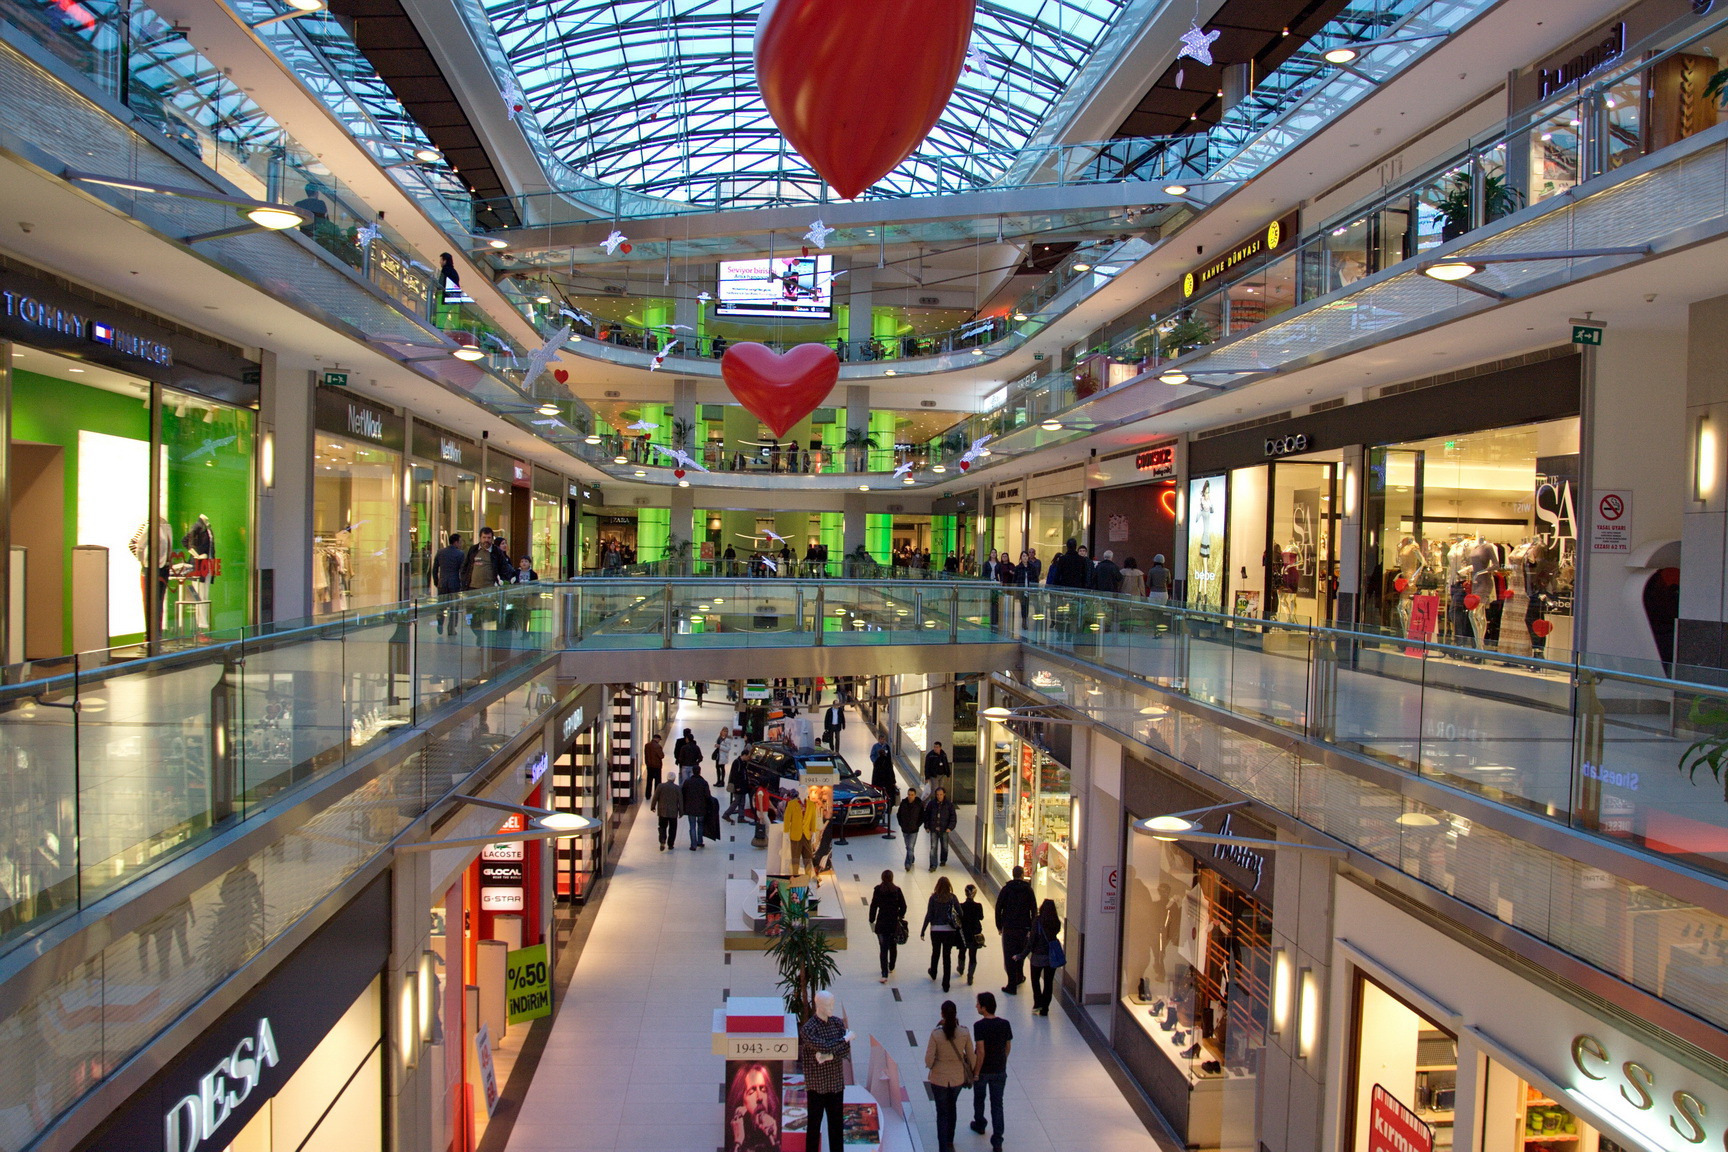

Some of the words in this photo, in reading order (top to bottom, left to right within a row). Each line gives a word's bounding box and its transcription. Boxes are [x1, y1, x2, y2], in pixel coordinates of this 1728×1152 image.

[728, 266, 752, 275] Seviyor
[1203, 261, 1224, 281] KAHVE
[1227, 240, 1260, 267] DÜNYASI
[3, 291, 89, 337] TOMMY
[348, 404, 382, 440] NetWork
[1264, 434, 1307, 456] bebe
[186, 558, 221, 577] LOVE
[1194, 569, 1215, 581] bebe
[483, 868, 522, 876] GLOCAL
[508, 961, 546, 990] %50
[736, 1043, 763, 1053] 1943
[164, 1017, 280, 1152] DESA
[1571, 1034, 1728, 1152] ess
